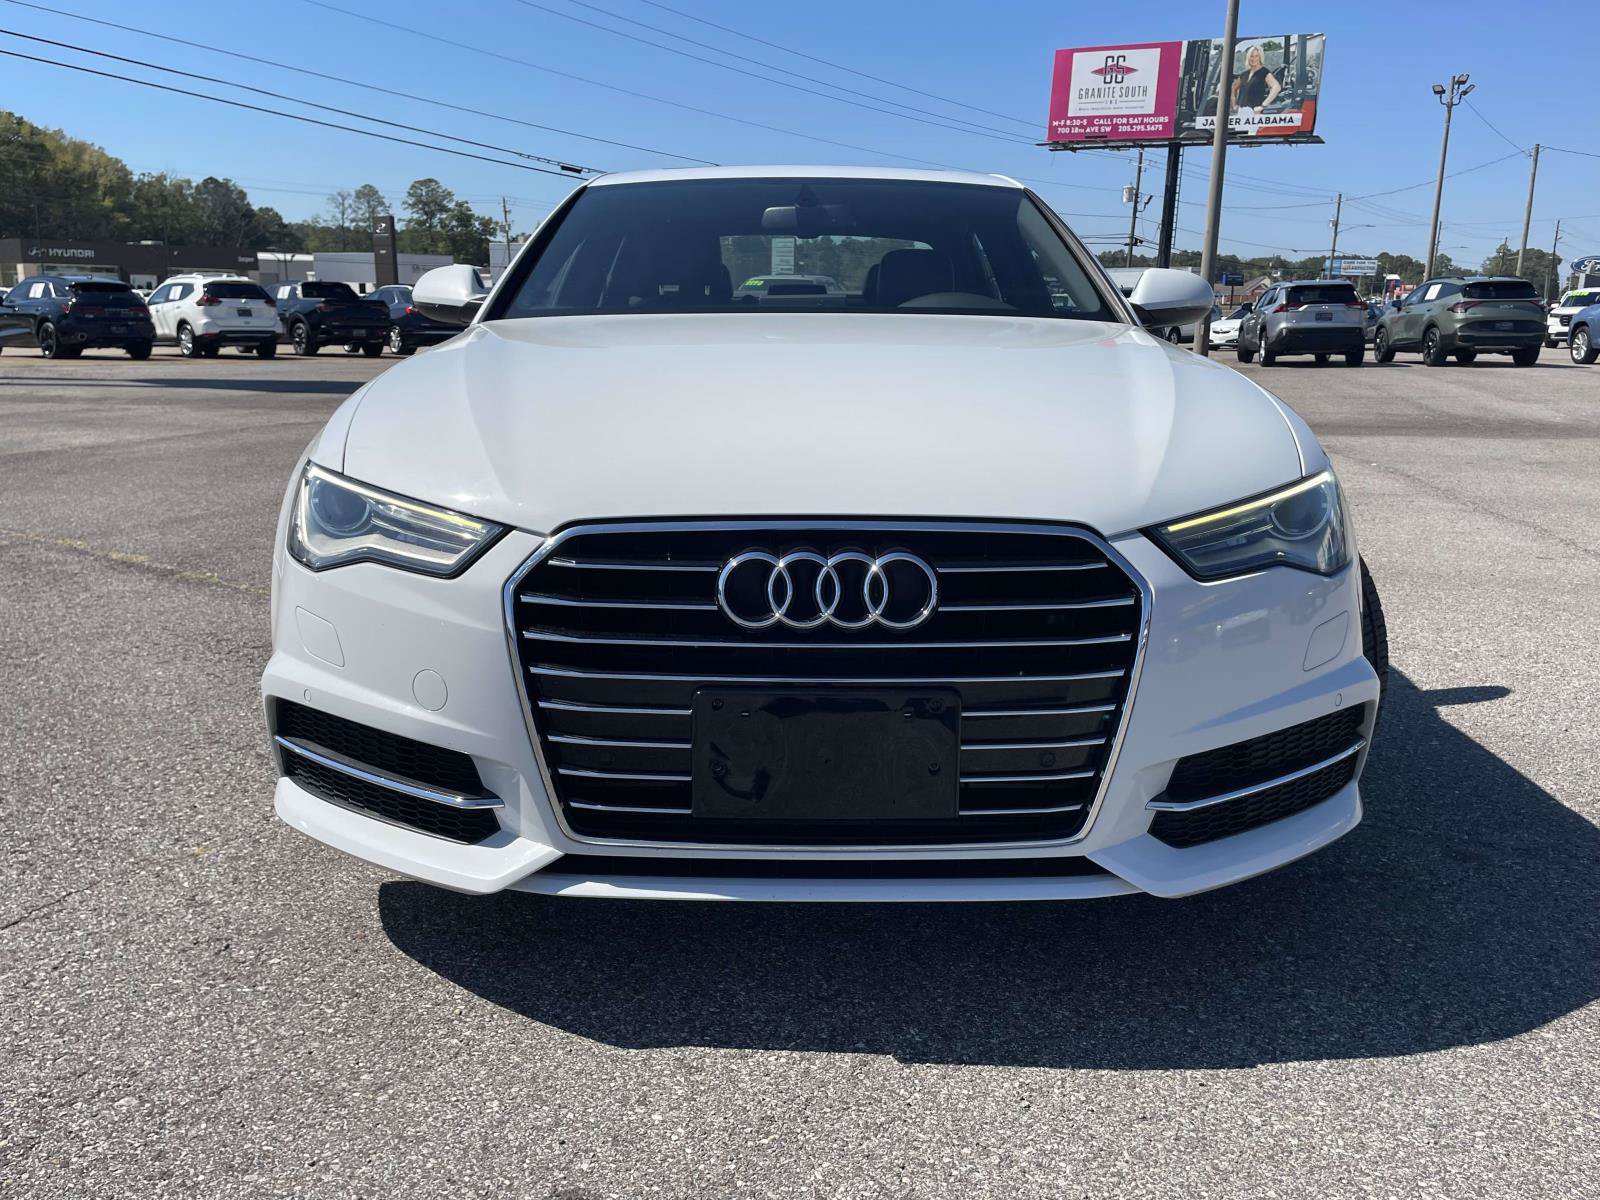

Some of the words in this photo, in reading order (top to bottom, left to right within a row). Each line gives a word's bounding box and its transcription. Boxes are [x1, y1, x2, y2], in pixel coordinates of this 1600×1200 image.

[1078, 87, 1116, 100] GRANITE
[1119, 85, 1147, 98] SOUTH
[1129, 116, 1143, 124] SAT
[1144, 116, 1169, 124] HOURS
[1202, 117, 1241, 127] JAER
[1244, 116, 1294, 125] ALABAMA
[48, 248, 95, 258] HYUNDAI
